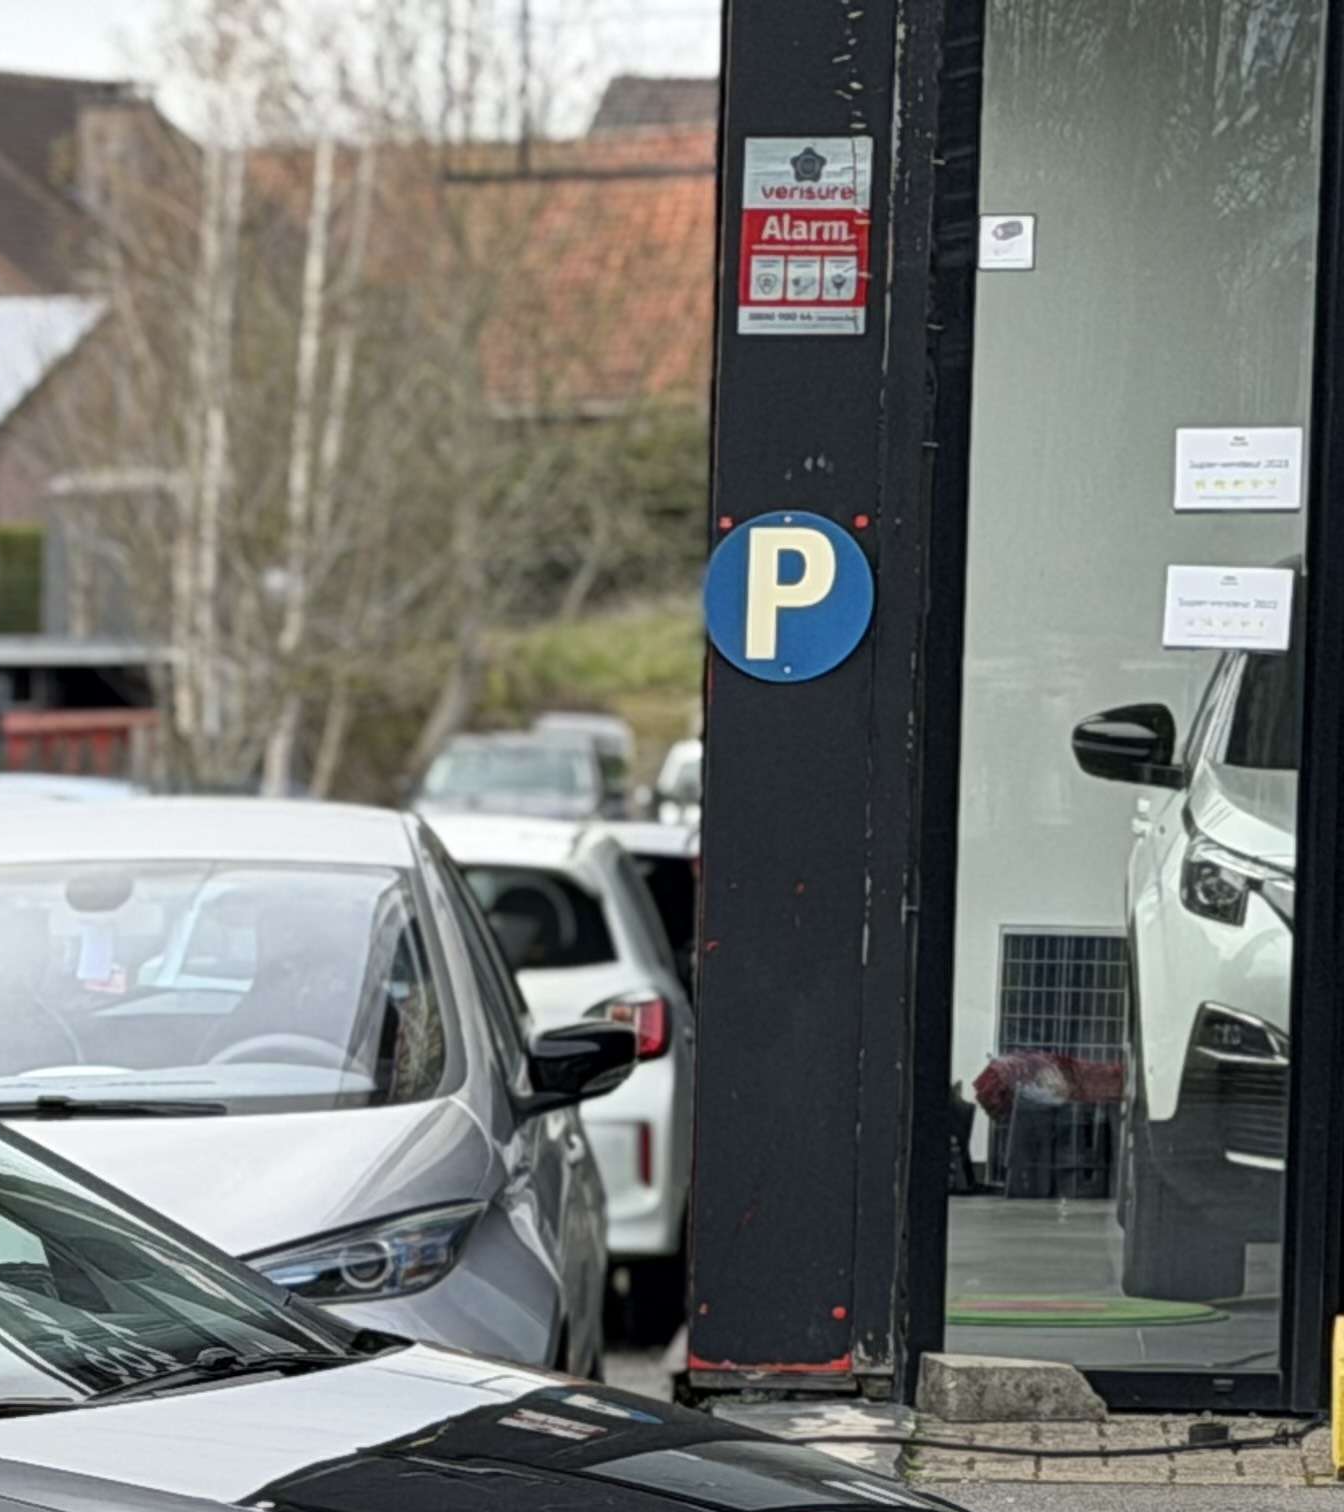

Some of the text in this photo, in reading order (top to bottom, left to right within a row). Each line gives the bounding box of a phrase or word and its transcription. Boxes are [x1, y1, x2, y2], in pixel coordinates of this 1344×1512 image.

[762, 185, 855, 200] verisure
[761, 213, 849, 242] Alarm
[745, 527, 836, 660] P
